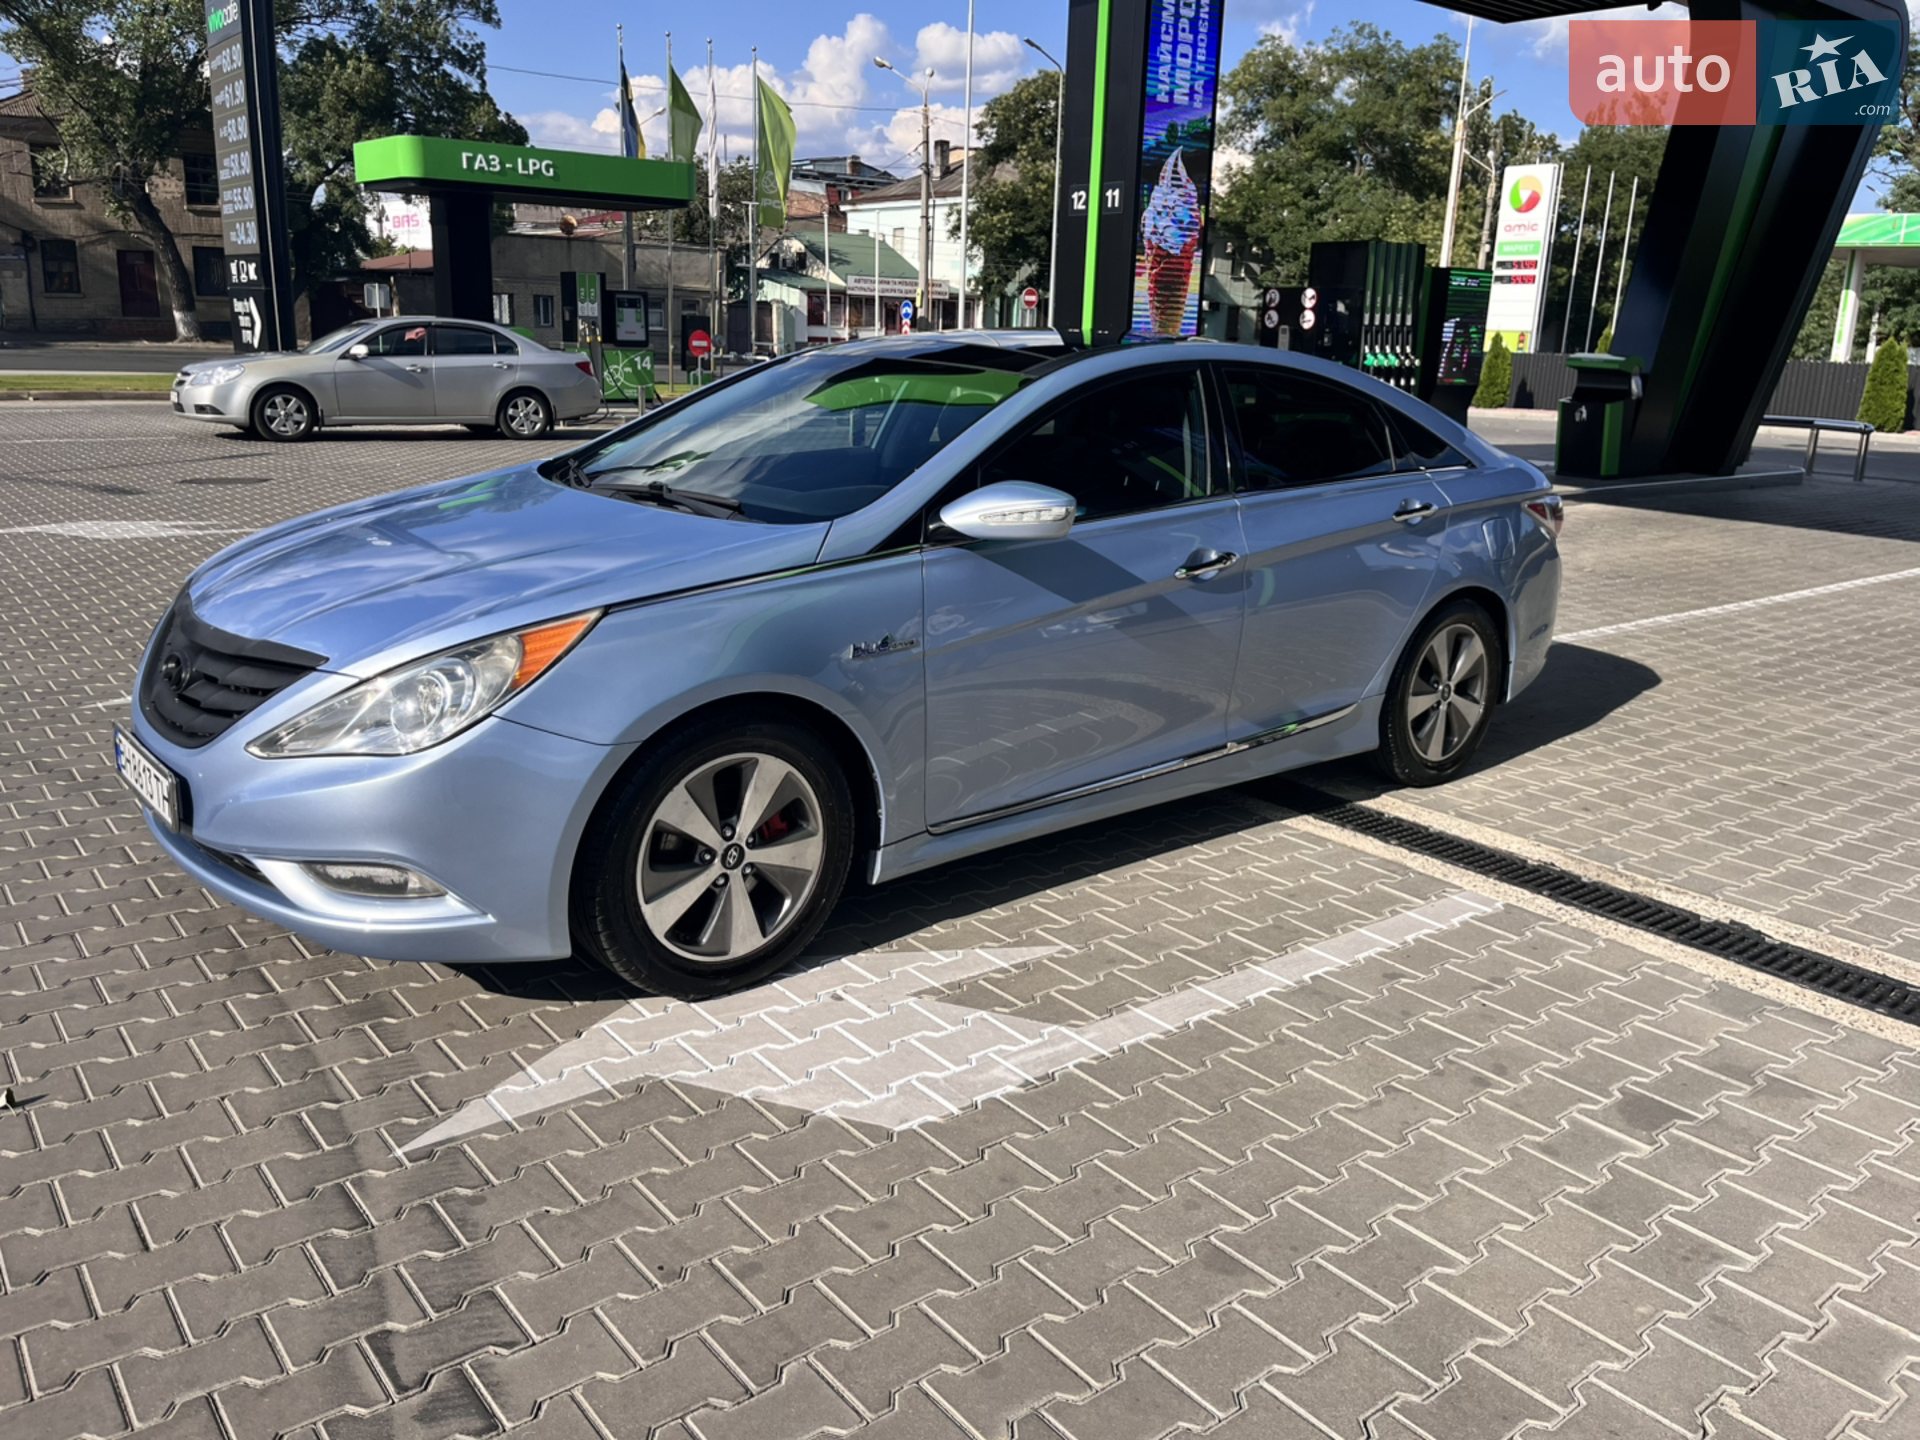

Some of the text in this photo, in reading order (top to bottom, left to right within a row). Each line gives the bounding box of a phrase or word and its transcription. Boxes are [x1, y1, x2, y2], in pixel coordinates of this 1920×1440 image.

[222, 43, 242, 73] 68.90
[225, 79, 245, 109] 61.90
[1193, 80, 1204, 109] НА
[227, 115, 248, 143] 58.90
[230, 150, 251, 177] 58.90
[461, 152, 500, 172] ГАЗ
[517, 157, 555, 177] LPG
[233, 186, 254, 211] 55.90
[1071, 190, 1087, 210] 12
[1105, 188, 1120, 208] 11
[236, 221, 256, 245] 34.30
[1503, 221, 1538, 233] amic
[1502, 243, 1534, 252] МАРКЕТ
[634, 356, 652, 371] 14
